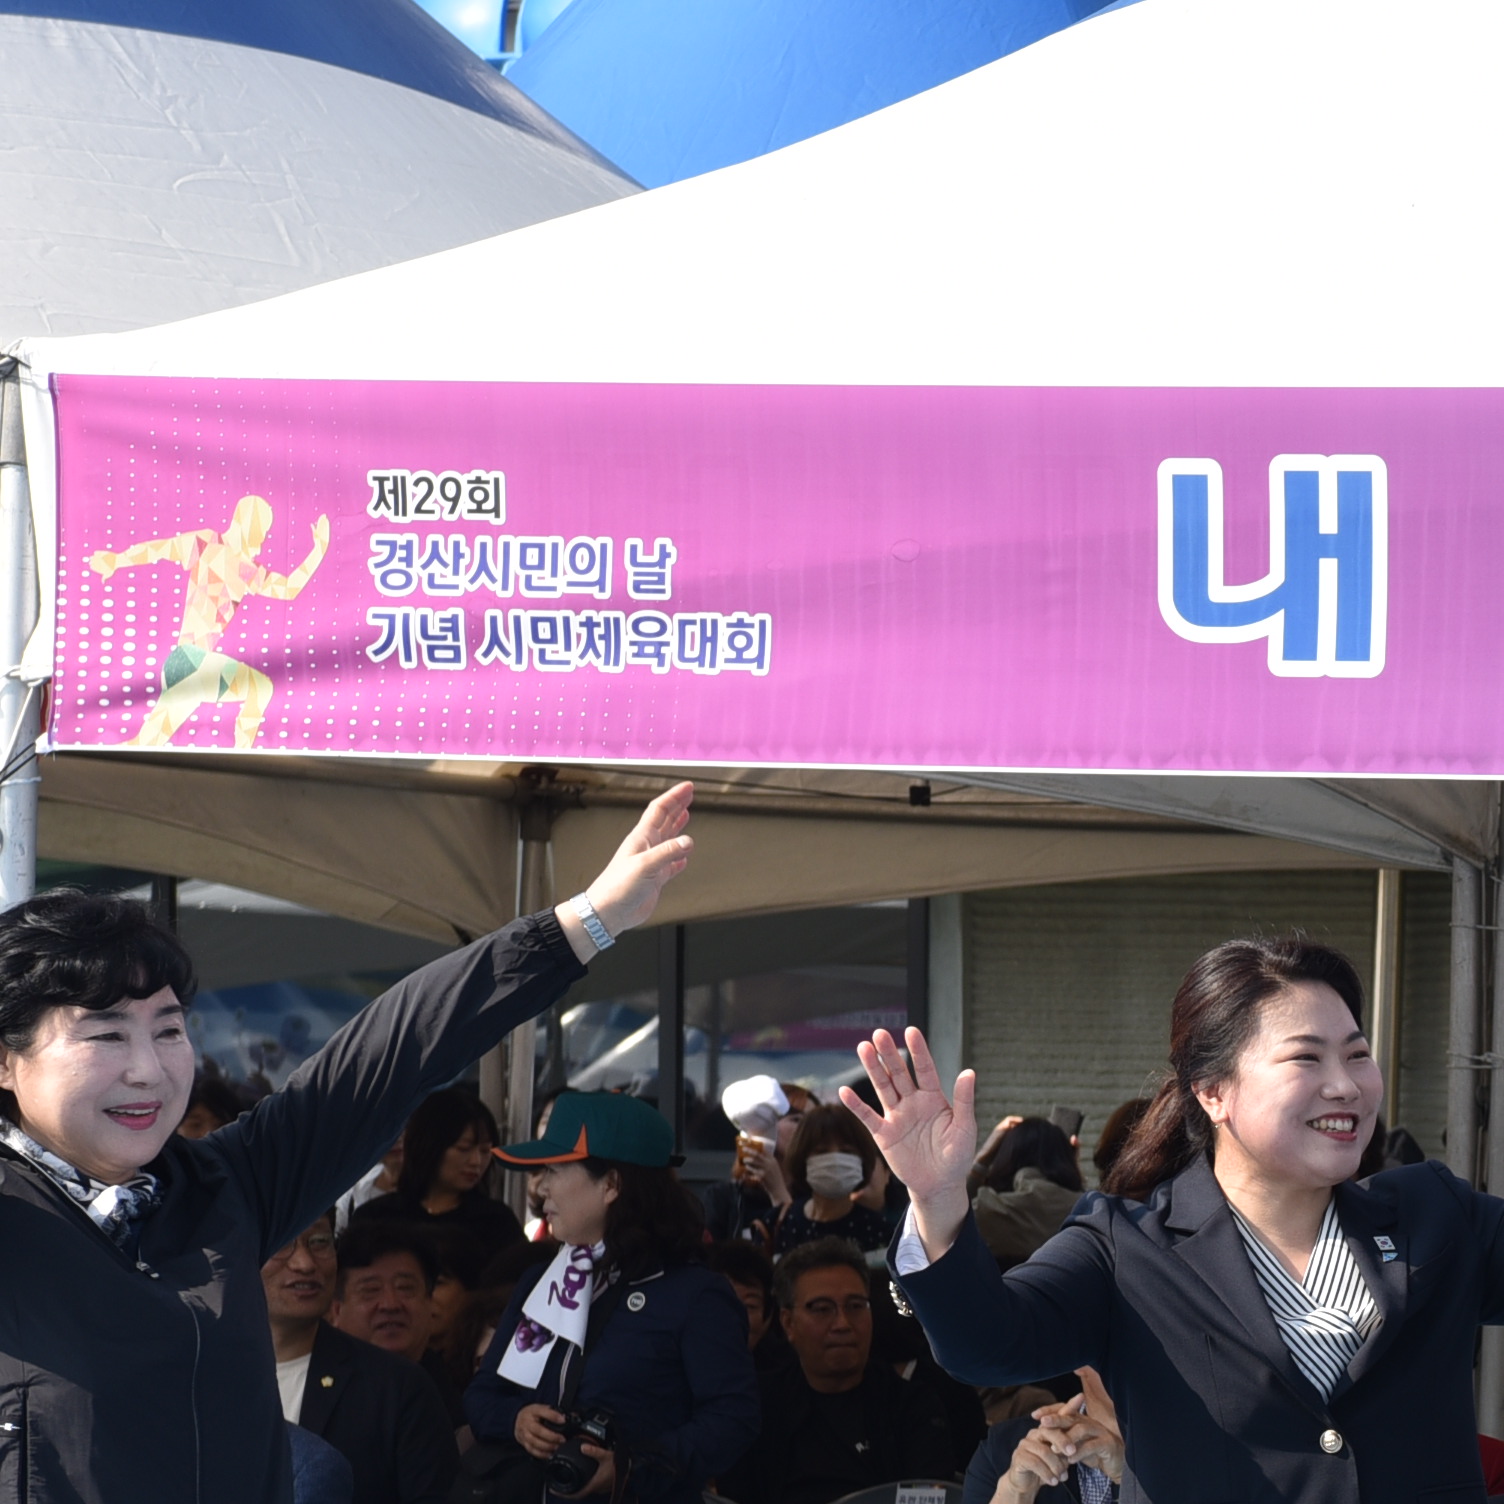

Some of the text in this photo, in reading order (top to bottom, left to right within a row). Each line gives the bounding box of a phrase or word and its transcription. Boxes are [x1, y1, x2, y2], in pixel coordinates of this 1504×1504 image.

[372, 475, 501, 519] 제29회
[373, 539, 672, 594] 경산시민의 날
[370, 612, 773, 670] 기념 시민체육대회
